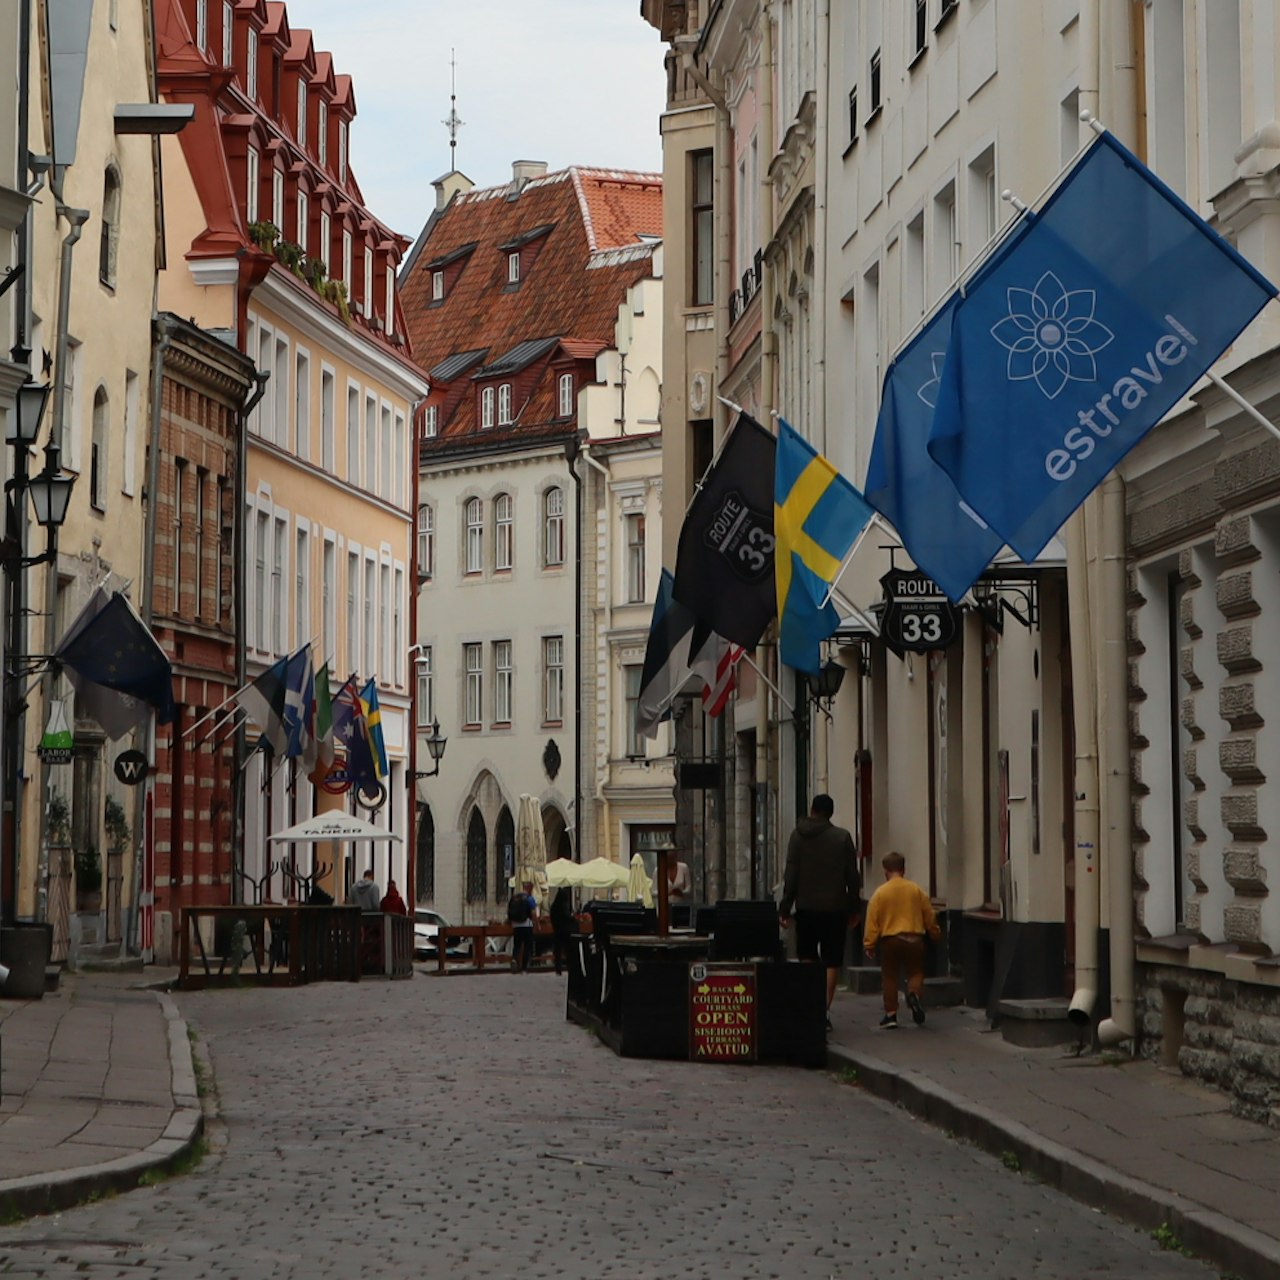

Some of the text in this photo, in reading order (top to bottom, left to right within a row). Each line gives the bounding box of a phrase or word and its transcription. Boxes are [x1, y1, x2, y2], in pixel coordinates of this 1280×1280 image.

[1044, 314, 1198, 481] estravel
[709, 498, 742, 544] ROUTE
[738, 526, 776, 570] 33
[902, 614, 942, 642] 33
[41, 749, 71, 757] LABOR
[119, 761, 144, 779] W
[302, 827, 363, 835] TANKER
[693, 995, 753, 1004] COURTYARD
[697, 1012, 748, 1025] OPEN
[694, 1027, 751, 1037] SISEHOOVI
[697, 1043, 750, 1055] AVATUD
